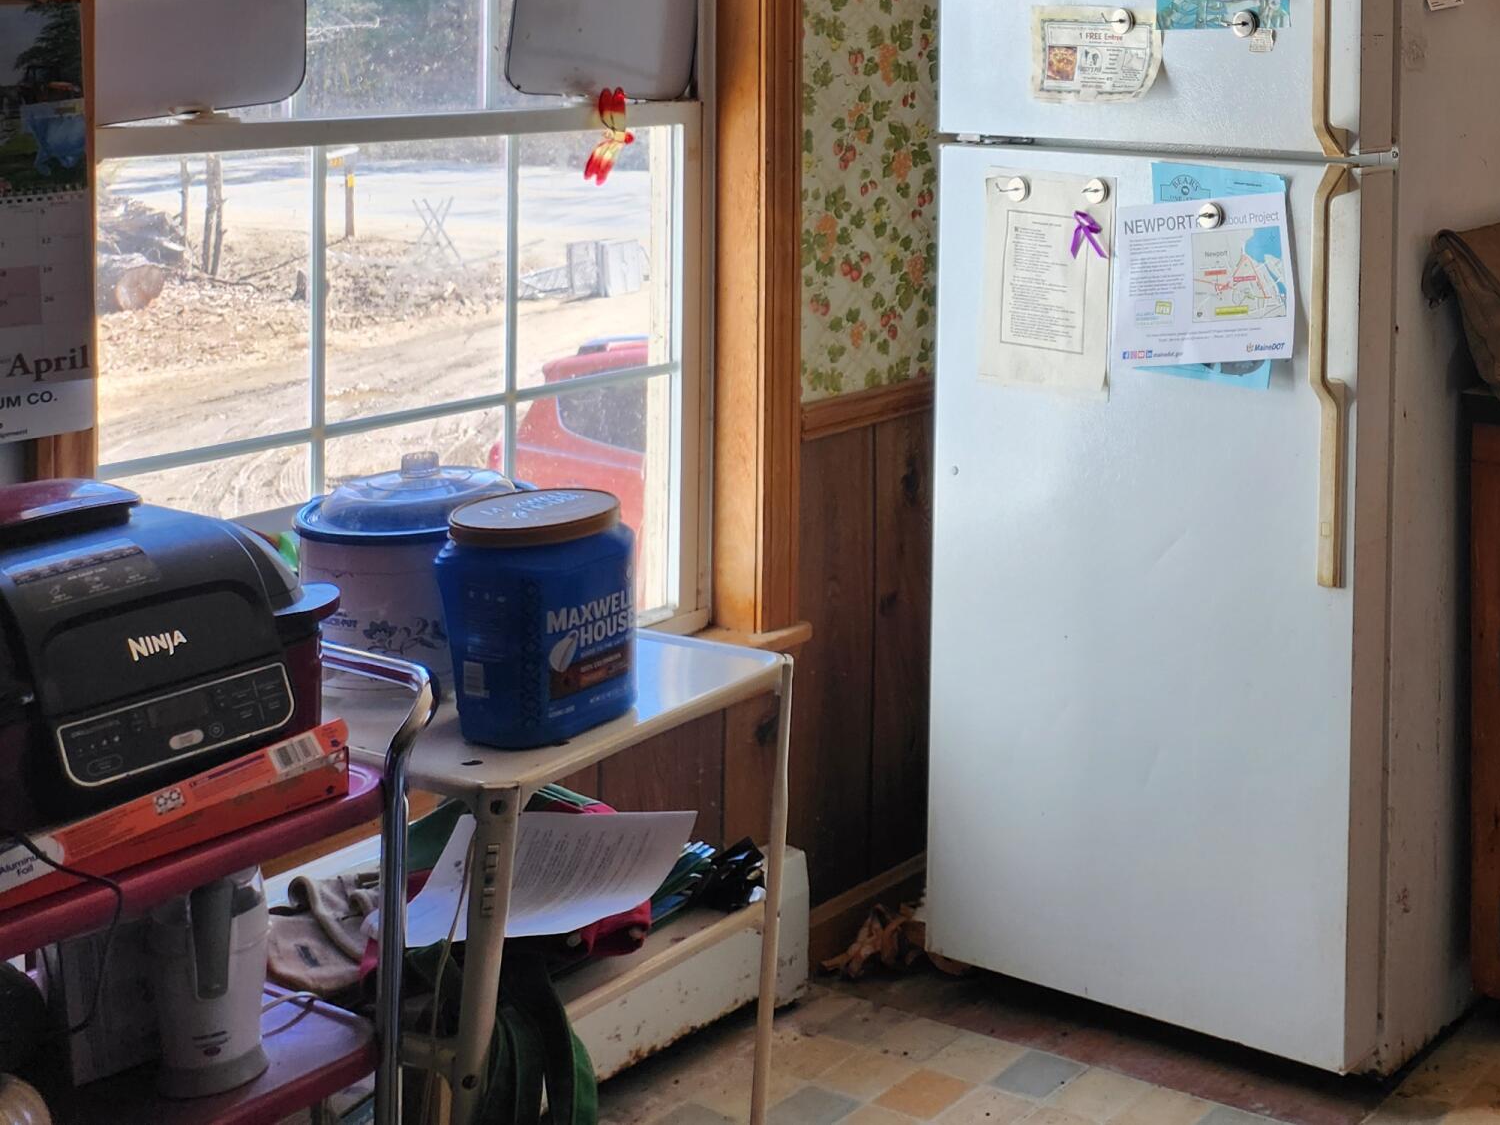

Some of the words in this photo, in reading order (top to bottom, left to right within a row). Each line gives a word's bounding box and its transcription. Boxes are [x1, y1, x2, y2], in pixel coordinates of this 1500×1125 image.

[1085, 32, 1102, 40] FREE
[1124, 214, 1194, 235] NEWPORT
[1250, 211, 1280, 223] Project
[1205, 250, 1228, 259] Newport
[7, 344, 90, 382] April
[27, 391, 58, 405] CO.
[580, 607, 636, 648] HOUSE
[127, 628, 188, 662] NINJA
[17, 864, 34, 877] Foil
